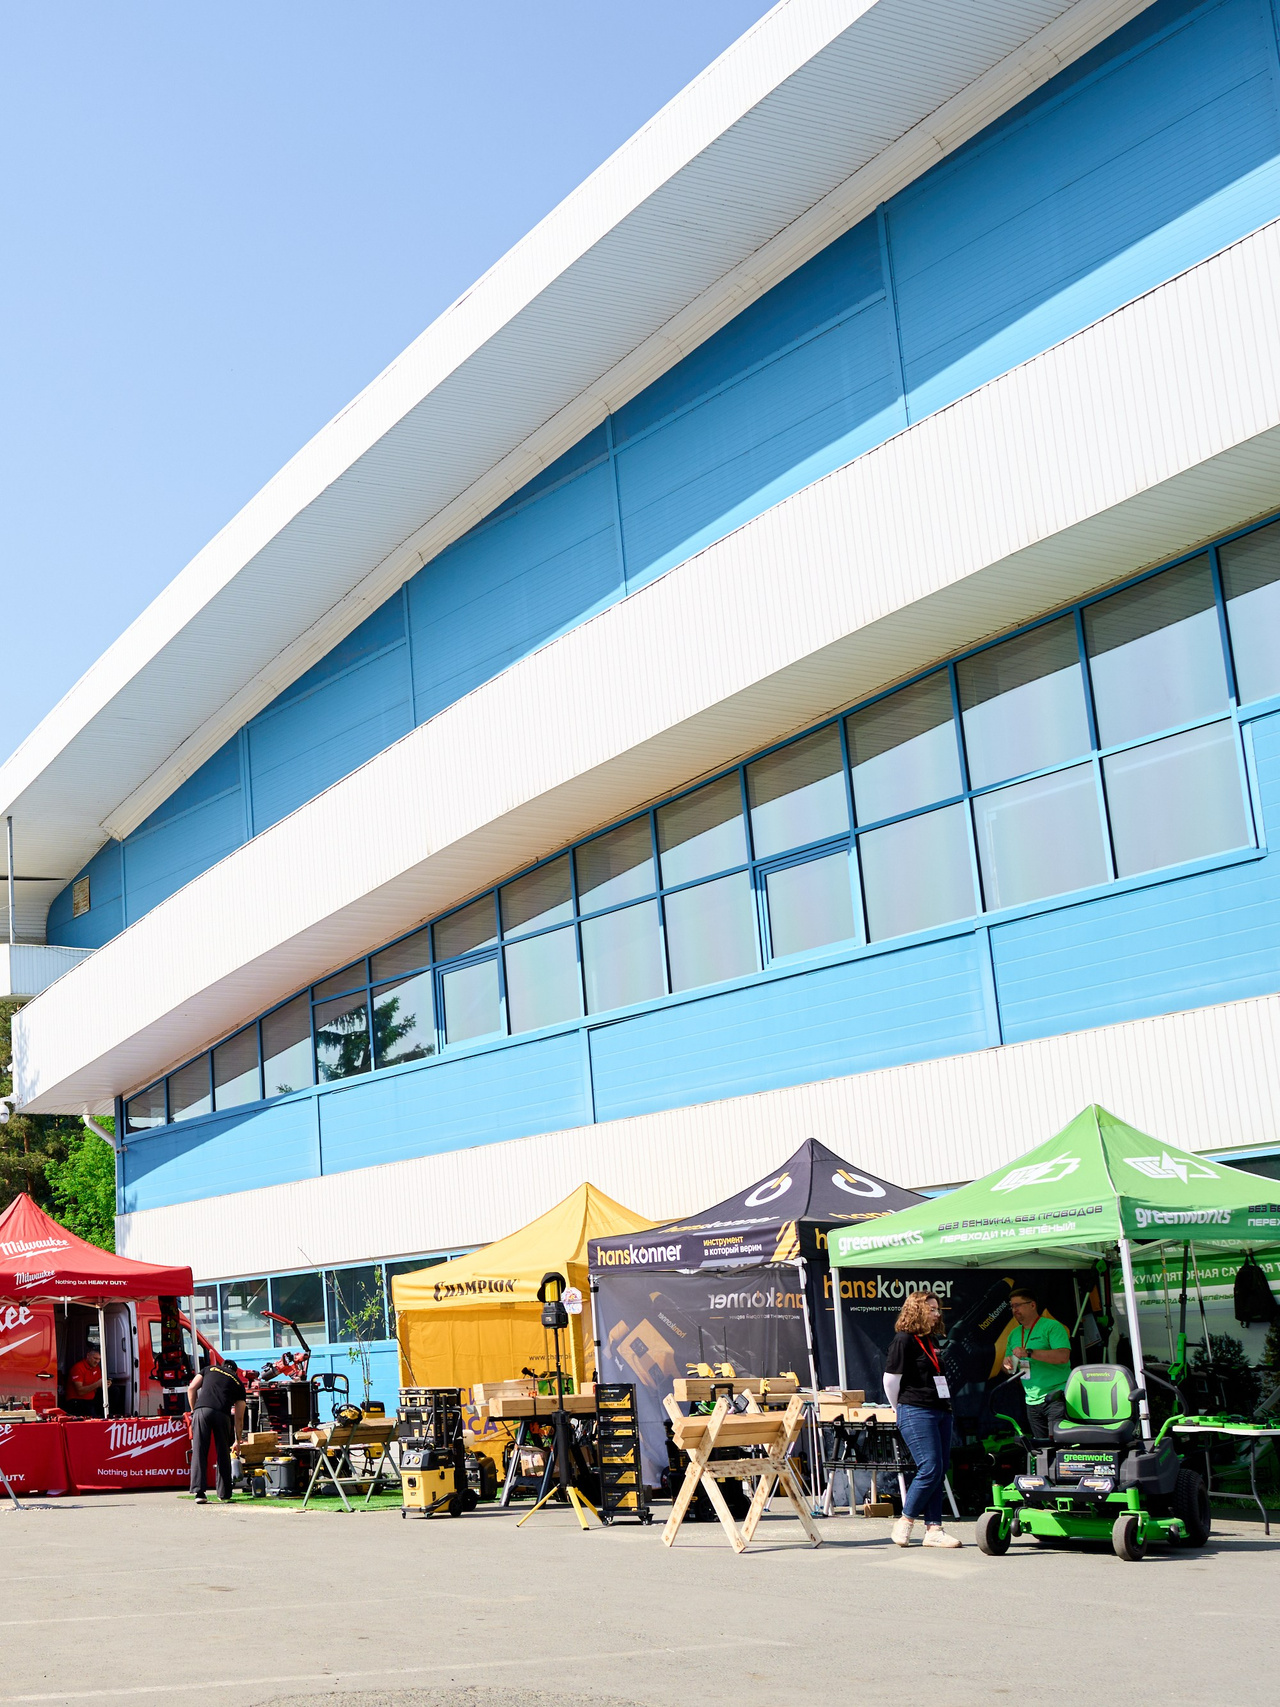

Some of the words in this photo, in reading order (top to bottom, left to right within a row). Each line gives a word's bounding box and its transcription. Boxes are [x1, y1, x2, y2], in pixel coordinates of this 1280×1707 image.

[1248, 1204, 1267, 1213] БЕЗ
[938, 1222, 959, 1232] БЕЗ
[1015, 1213, 1036, 1223] БЕЗ
[1038, 1205, 1103, 1220] ПРОВОДОВ
[1135, 1208, 1232, 1228] greenworks
[1248, 1218, 1280, 1227] ПЕРЕХ
[703, 1236, 743, 1247] инструмент
[940, 1231, 999, 1244] ПЕРЕХОДИ
[1001, 1229, 1016, 1237] НА
[1018, 1221, 1076, 1236] ЗЕЛЁНЫЙ!
[709, 1246, 739, 1256] который
[740, 1244, 762, 1254] верим
[838, 1229, 924, 1256] greenworks
[597, 1243, 682, 1266] hanskonner
[14, 1270, 55, 1286] Milwaukee
[434, 1279, 517, 1302] CHAMPION
[978, 1300, 1008, 1331] hanskonner
[1063, 1453, 1114, 1463] greenworks
[97, 1468, 128, 1477] Nothing
[145, 1468, 174, 1476] HEAVY
[177, 1468, 191, 1476] DU
